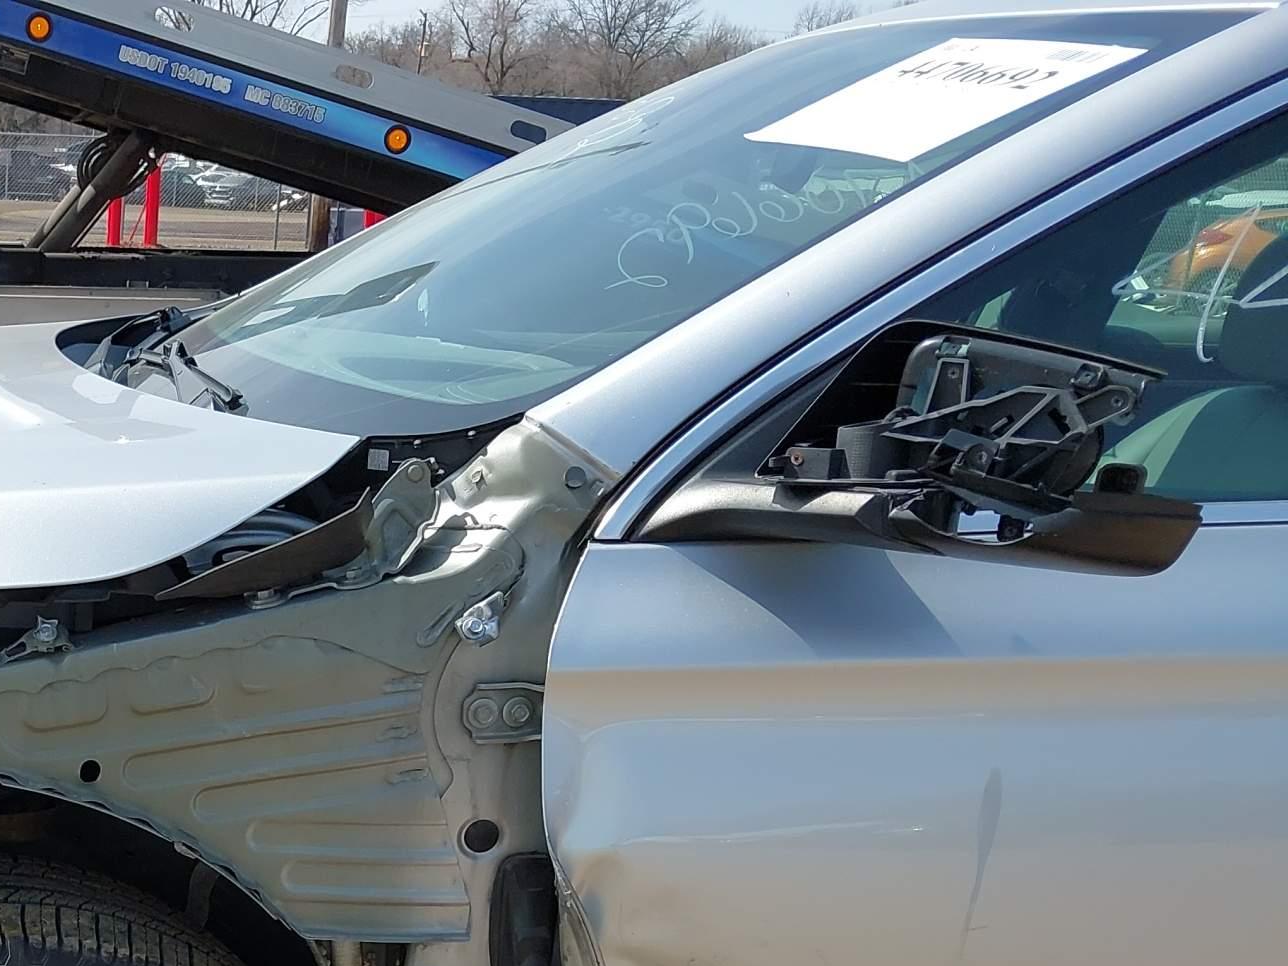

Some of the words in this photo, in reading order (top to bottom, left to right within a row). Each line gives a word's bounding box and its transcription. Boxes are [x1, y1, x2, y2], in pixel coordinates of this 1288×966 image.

[118, 45, 169, 74] USDOT
[244, 85, 271, 106] MC
[897, 59, 1060, 90] 44706692
